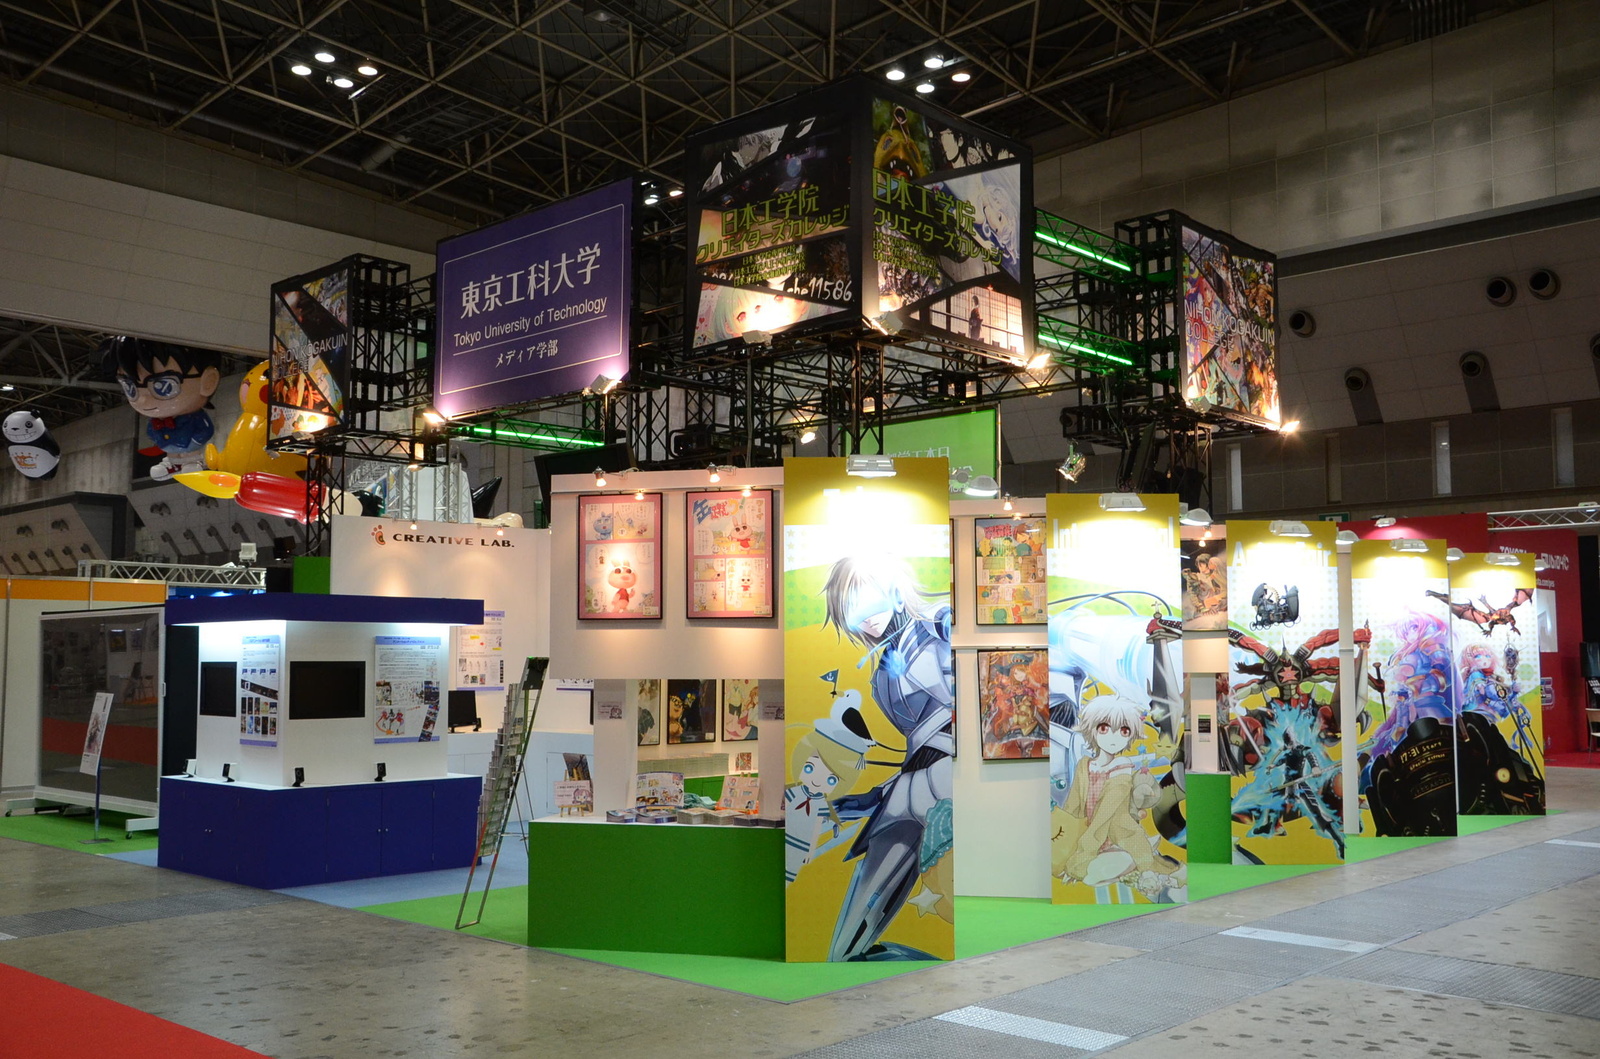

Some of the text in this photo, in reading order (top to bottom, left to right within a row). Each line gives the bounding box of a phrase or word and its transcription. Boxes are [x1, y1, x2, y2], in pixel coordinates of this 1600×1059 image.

[721, 185, 820, 236] 日本工学院
[872, 168, 976, 235] 日本工学院
[696, 204, 850, 264] クリエイターズカレッジ
[872, 207, 1003, 266] クリエイターズカレッジ
[460, 242, 601, 320] 東京工科大学
[300, 332, 348, 358] KOGAKUIN
[454, 297, 607, 347] Tokyo University of Technology
[1184, 299, 1275, 346] NIHON KOGAKUIN
[495, 339, 559, 368] メディア学部
[393, 533, 515, 548] CREATIVE LAB.
